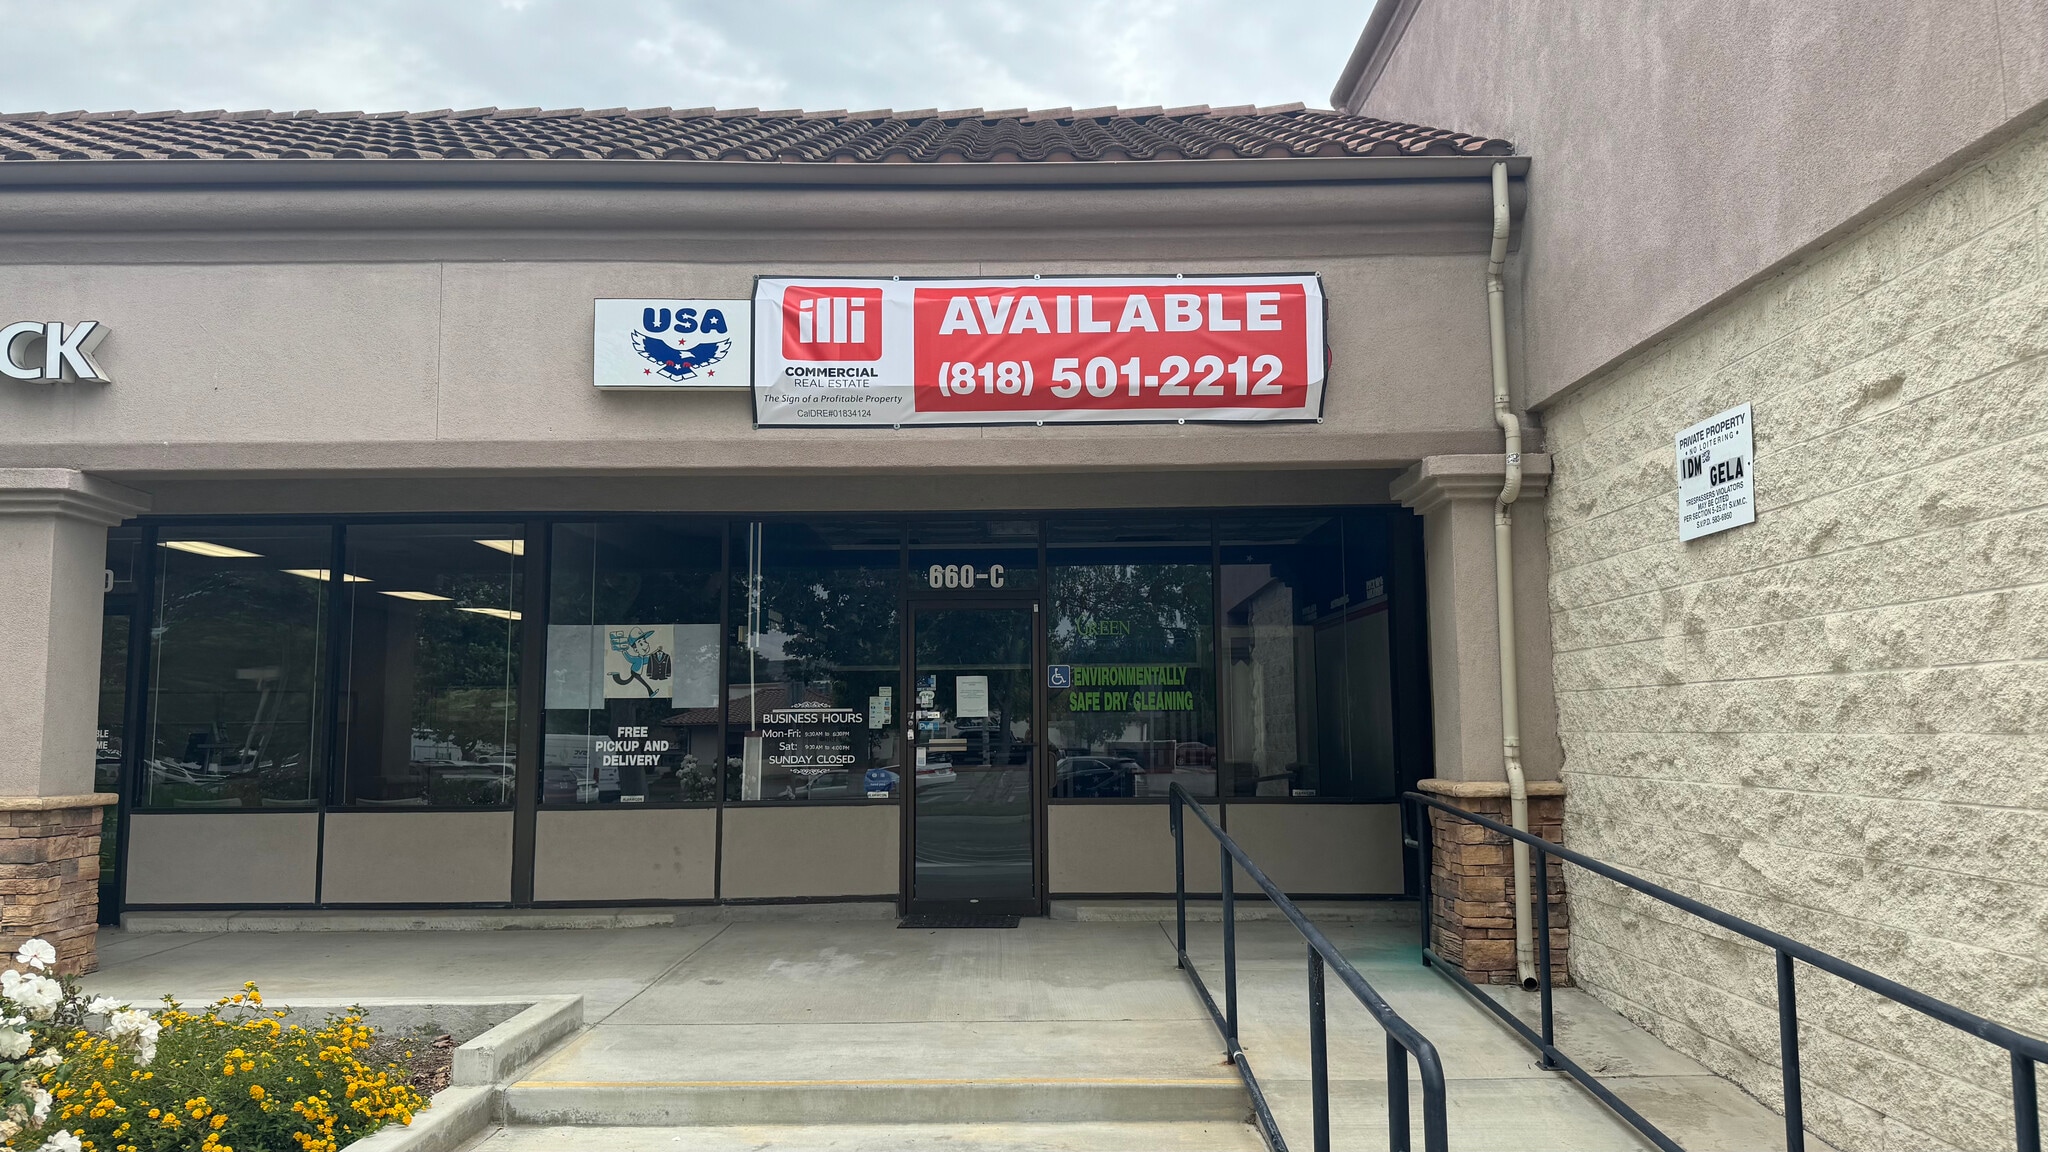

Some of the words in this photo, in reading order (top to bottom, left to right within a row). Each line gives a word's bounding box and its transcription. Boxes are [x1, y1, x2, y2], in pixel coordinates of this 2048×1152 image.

[643, 307, 728, 334] USA
[799, 297, 865, 344] illi
[938, 291, 1283, 335] AVAILABLE
[785, 366, 879, 378] COMMERCIAL
[938, 360, 1034, 397] (818)
[1050, 354, 1284, 399] 501-2212
[794, 379, 824, 388] REAL
[828, 379, 870, 388] ESTATE
[764, 394, 780, 403] The
[781, 394, 800, 404] Sign
[802, 394, 813, 403] of
[820, 394, 864, 403] Profitable
[865, 394, 903, 405] Property
[797, 409, 872, 418] CalDRE#01834124
[1679, 430, 1705, 450] PRIVATE
[1705, 413, 1746, 438] PROPERTY
[1689, 446, 1698, 456] NO
[1699, 431, 1734, 451] LOITERING
[1710, 457, 1744, 487] GELA
[1685, 490, 1716, 507] TRESPASSERS
[1716, 481, 1744, 496] VIOLATORS
[1697, 501, 1708, 511] MAY
[1707, 499, 1714, 508] BE
[1714, 494, 1730, 505] CITED
[1683, 514, 1693, 523] PER
[1692, 508, 1712, 521] SECTION
[929, 564, 1004, 589] 660-C
[1073, 666, 1188, 686] ENVIRONMENTALLY
[1069, 691, 1100, 712] SAFE
[1104, 691, 1129, 711] DRY
[1132, 690, 1194, 712] CLEANING
[762, 713, 818, 724] BUSINESS
[822, 713, 863, 724] HOURS
[617, 726, 649, 738] FREE
[761, 729, 802, 738] Mon-Fri:
[595, 740, 640, 752] PICKUP
[643, 740, 670, 752] AND
[778, 742, 798, 751] Sat:
[602, 754, 661, 766] DELIVERY
[768, 755, 813, 765] SUNDAY
[816, 754, 856, 764] CLOSED
